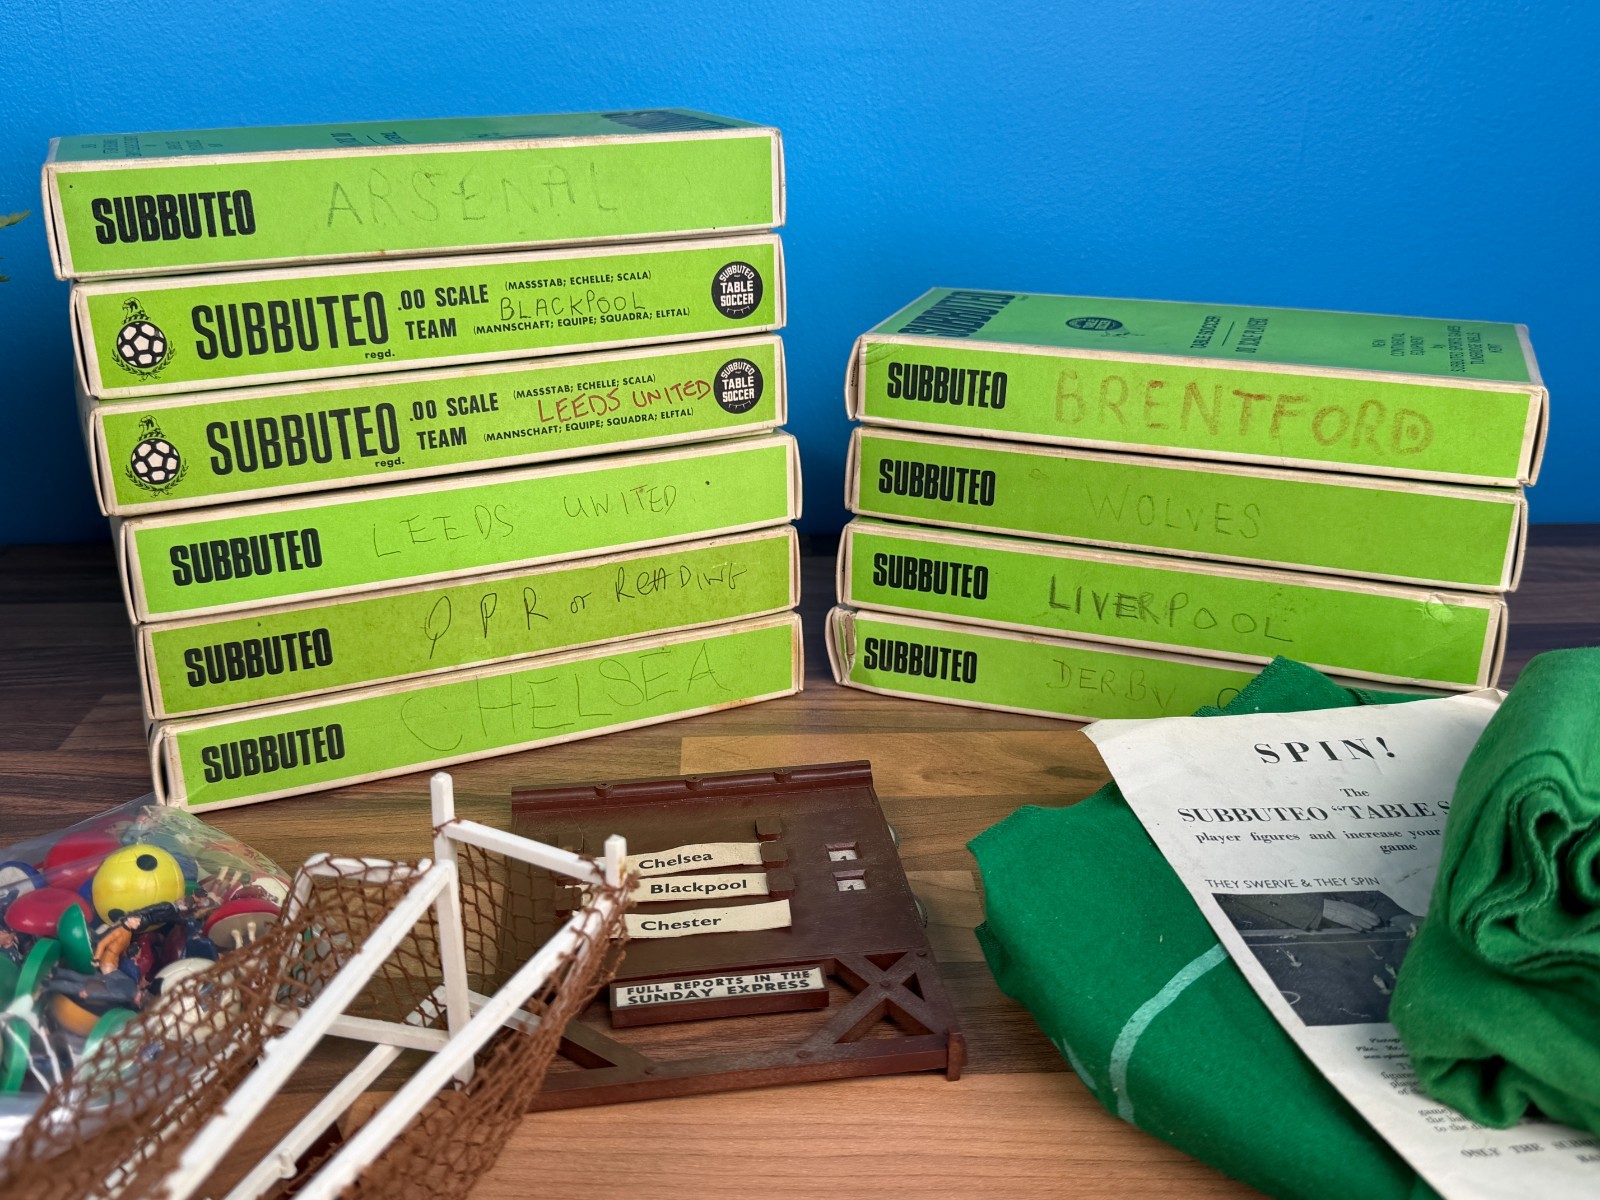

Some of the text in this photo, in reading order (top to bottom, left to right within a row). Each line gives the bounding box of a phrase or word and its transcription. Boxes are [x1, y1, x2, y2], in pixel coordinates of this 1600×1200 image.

[326, 162, 618, 228] ARSENAL
[92, 189, 256, 244] SUBBUTEO
[505, 270, 652, 291] (MASSSTAB; ECHELLE; SCALA)
[720, 281, 754, 294] TABLE
[435, 284, 489, 307] SCALE
[500, 289, 647, 321] BLACKPOOL
[720, 292, 754, 307] SOCCER
[192, 291, 389, 360] SUBBUTEO
[474, 306, 691, 336] (MANNSCHAFT; EQUIPE; SQUADRA; ELFTAL)
[897, 291, 1016, 338] SUBBUTEO
[405, 318, 457, 341] TEAM
[365, 349, 395, 360] regd.
[513, 373, 656, 400] (MASSSTAB; ECHELLE; SCALA)
[722, 376, 754, 390] TABLE
[722, 388, 755, 403] SOCCER
[887, 361, 1008, 409] SUBBUTEO
[447, 392, 499, 416] SCALE
[537, 379, 712, 424] LEEDS UNITED
[1055, 369, 1435, 457] BRENTFORD
[206, 402, 400, 475] SUBBUTEO
[417, 426, 467, 451] TEAM
[484, 407, 694, 443] (MANNSCHAFT; EQUIPE; SQUADRA; ELFTAL)
[375, 457, 405, 468] regd.
[878, 458, 996, 507] SUBBUTEO
[1085, 484, 1261, 538] WOLVES
[373, 504, 514, 558] LEEDS
[169, 528, 323, 587] SUBBUTEO
[872, 552, 989, 600] SUBBUTEO
[570, 592, 592, 613] or
[1048, 574, 1294, 642] LIVERPOOL
[184, 628, 333, 687] SUBBUTEO
[864, 637, 978, 684] SUBBUTEO
[400, 643, 731, 751] CHELSEA
[1046, 658, 1177, 711] DERBY
[201, 723, 345, 783] SUBBUTEO
[1253, 736, 1396, 764] SPIN!
[1340, 788, 1369, 798] The
[1177, 805, 1328, 823] SUBBUTEO
[1194, 829, 1441, 844] player figures and increase your
[1380, 843, 1418, 855] game
[638, 851, 714, 870] Chelsea
[650, 879, 748, 896] Blackpool
[1205, 876, 1381, 890] THEY SWERVE & THEY SPIN
[640, 916, 722, 931] Chester
[626, 970, 811, 996] FULL REPORTS IN THE
[627, 979, 811, 1005] SUNDAY EXPRESS
